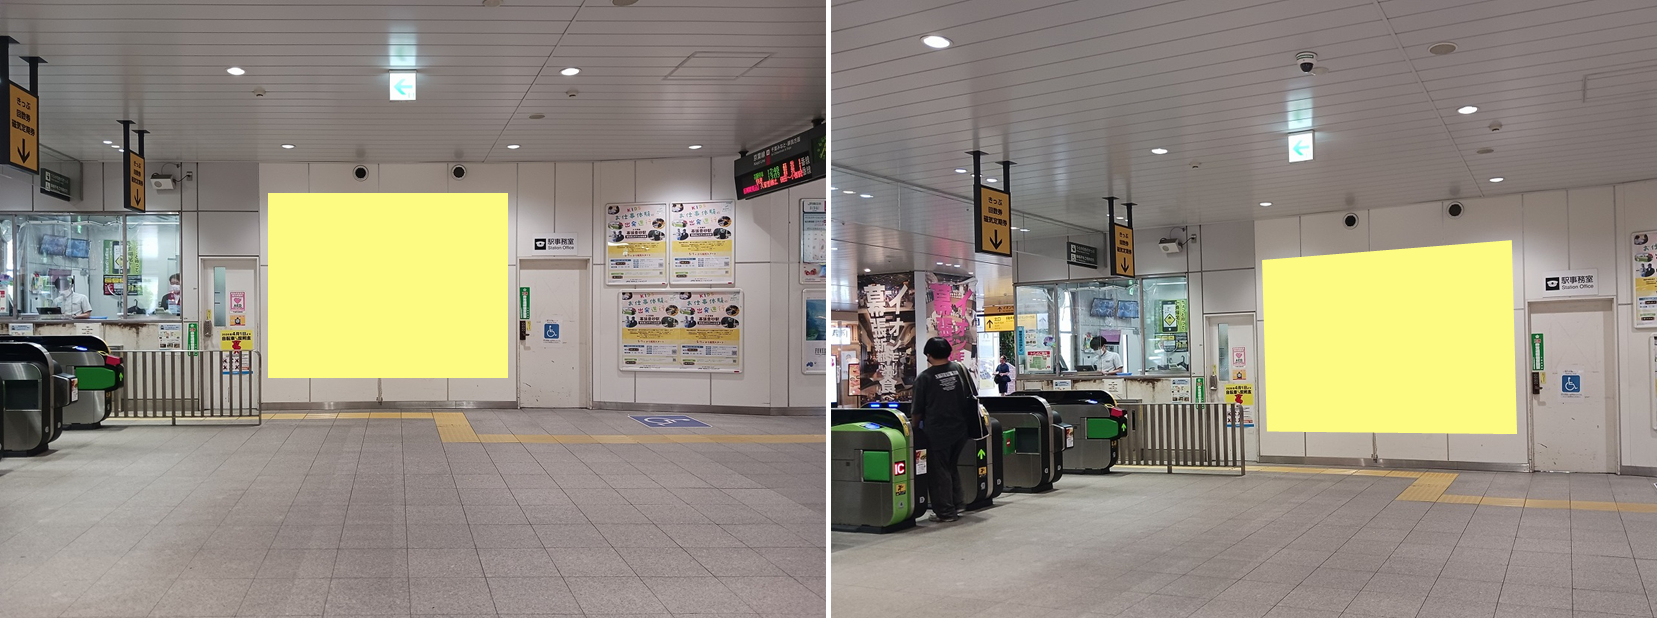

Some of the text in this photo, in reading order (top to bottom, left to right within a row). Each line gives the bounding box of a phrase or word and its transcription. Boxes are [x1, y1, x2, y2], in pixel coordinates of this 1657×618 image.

[16, 97, 31, 110] きっぷ
[16, 109, 31, 122] 回数券
[11, 119, 35, 137] 磁気定期券
[988, 196, 1003, 206] きっぷ
[988, 206, 1003, 216] 回数券
[983, 215, 1008, 227] 磁気定期券
[1561, 275, 1593, 285] 駅事務室
[895, 462, 905, 475] IC
